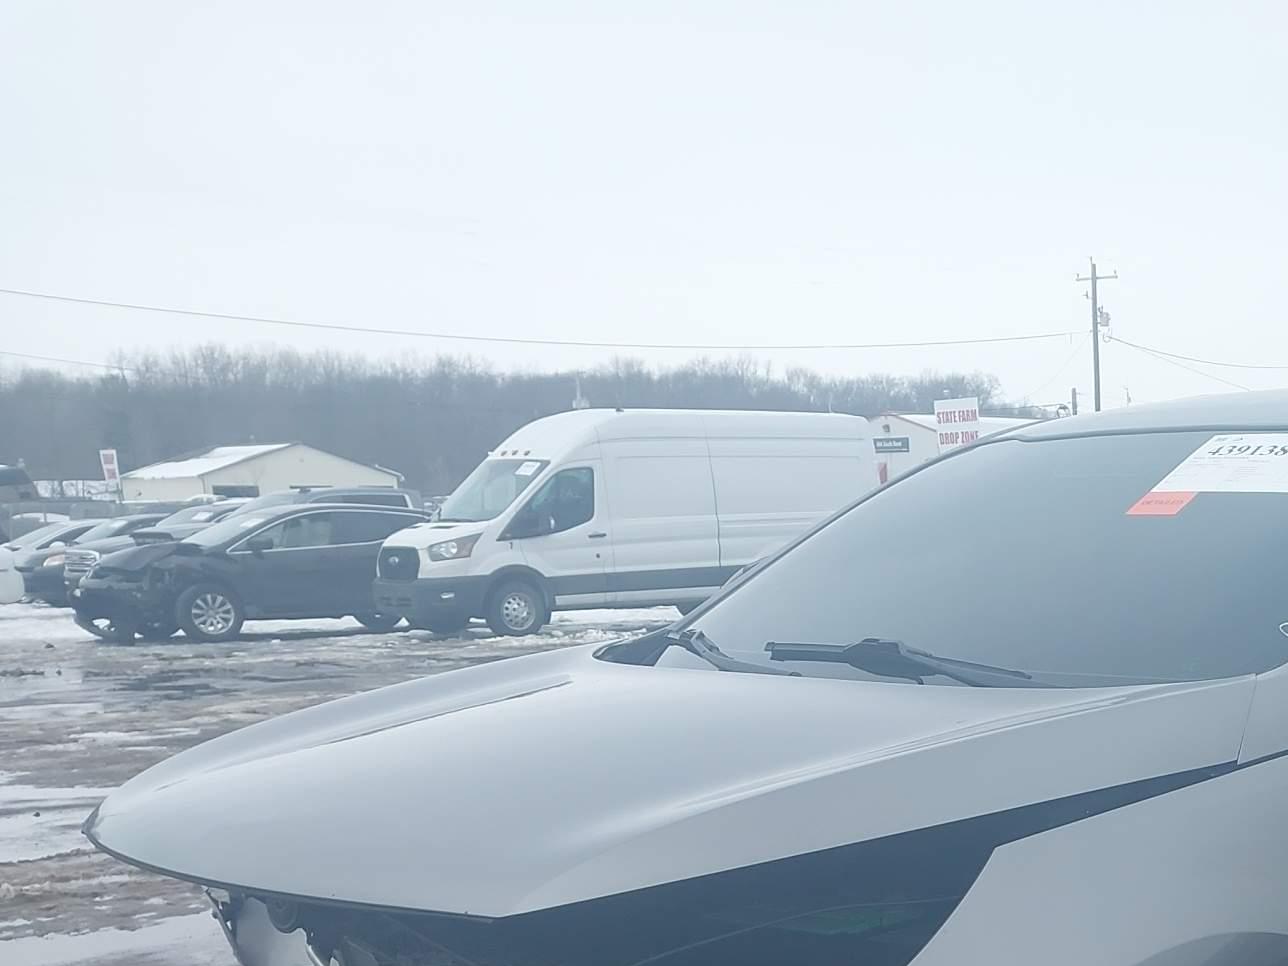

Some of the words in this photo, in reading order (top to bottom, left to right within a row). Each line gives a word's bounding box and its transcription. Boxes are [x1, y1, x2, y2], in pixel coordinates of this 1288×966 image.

[937, 410, 957, 424] STATE
[959, 409, 978, 423] FARM
[939, 432, 960, 446] DROP
[961, 431, 979, 445] ZONE
